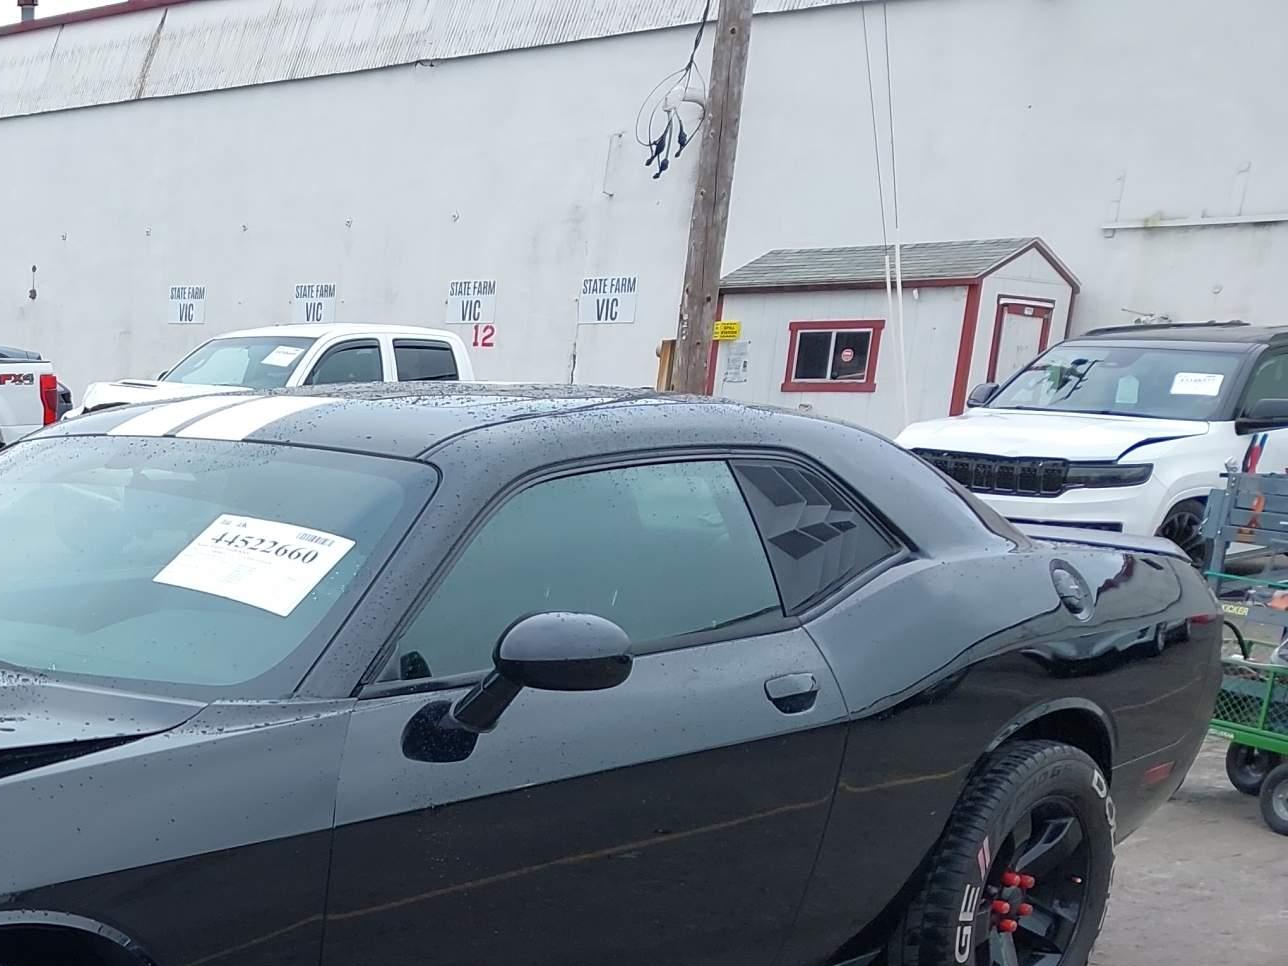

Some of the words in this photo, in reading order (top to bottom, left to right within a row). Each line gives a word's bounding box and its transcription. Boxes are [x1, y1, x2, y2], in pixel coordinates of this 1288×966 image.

[170, 286, 187, 300] STATE
[188, 286, 206, 300] FARM
[295, 285, 314, 298] STATE
[316, 284, 336, 298] FARM
[450, 281, 471, 296] STATE
[473, 280, 496, 296] FARM
[583, 278, 608, 294] STATE
[610, 277, 637, 293] FARM
[179, 303, 194, 322] VIC
[305, 302, 322, 322] VIC
[461, 299, 481, 321] VIC
[596, 298, 618, 321] VIC
[472, 324, 495, 347] 12
[0, 373, 35, 386] FX4
[211, 532, 319, 564] 44522660
[1222, 603, 1250, 617] KICKER
